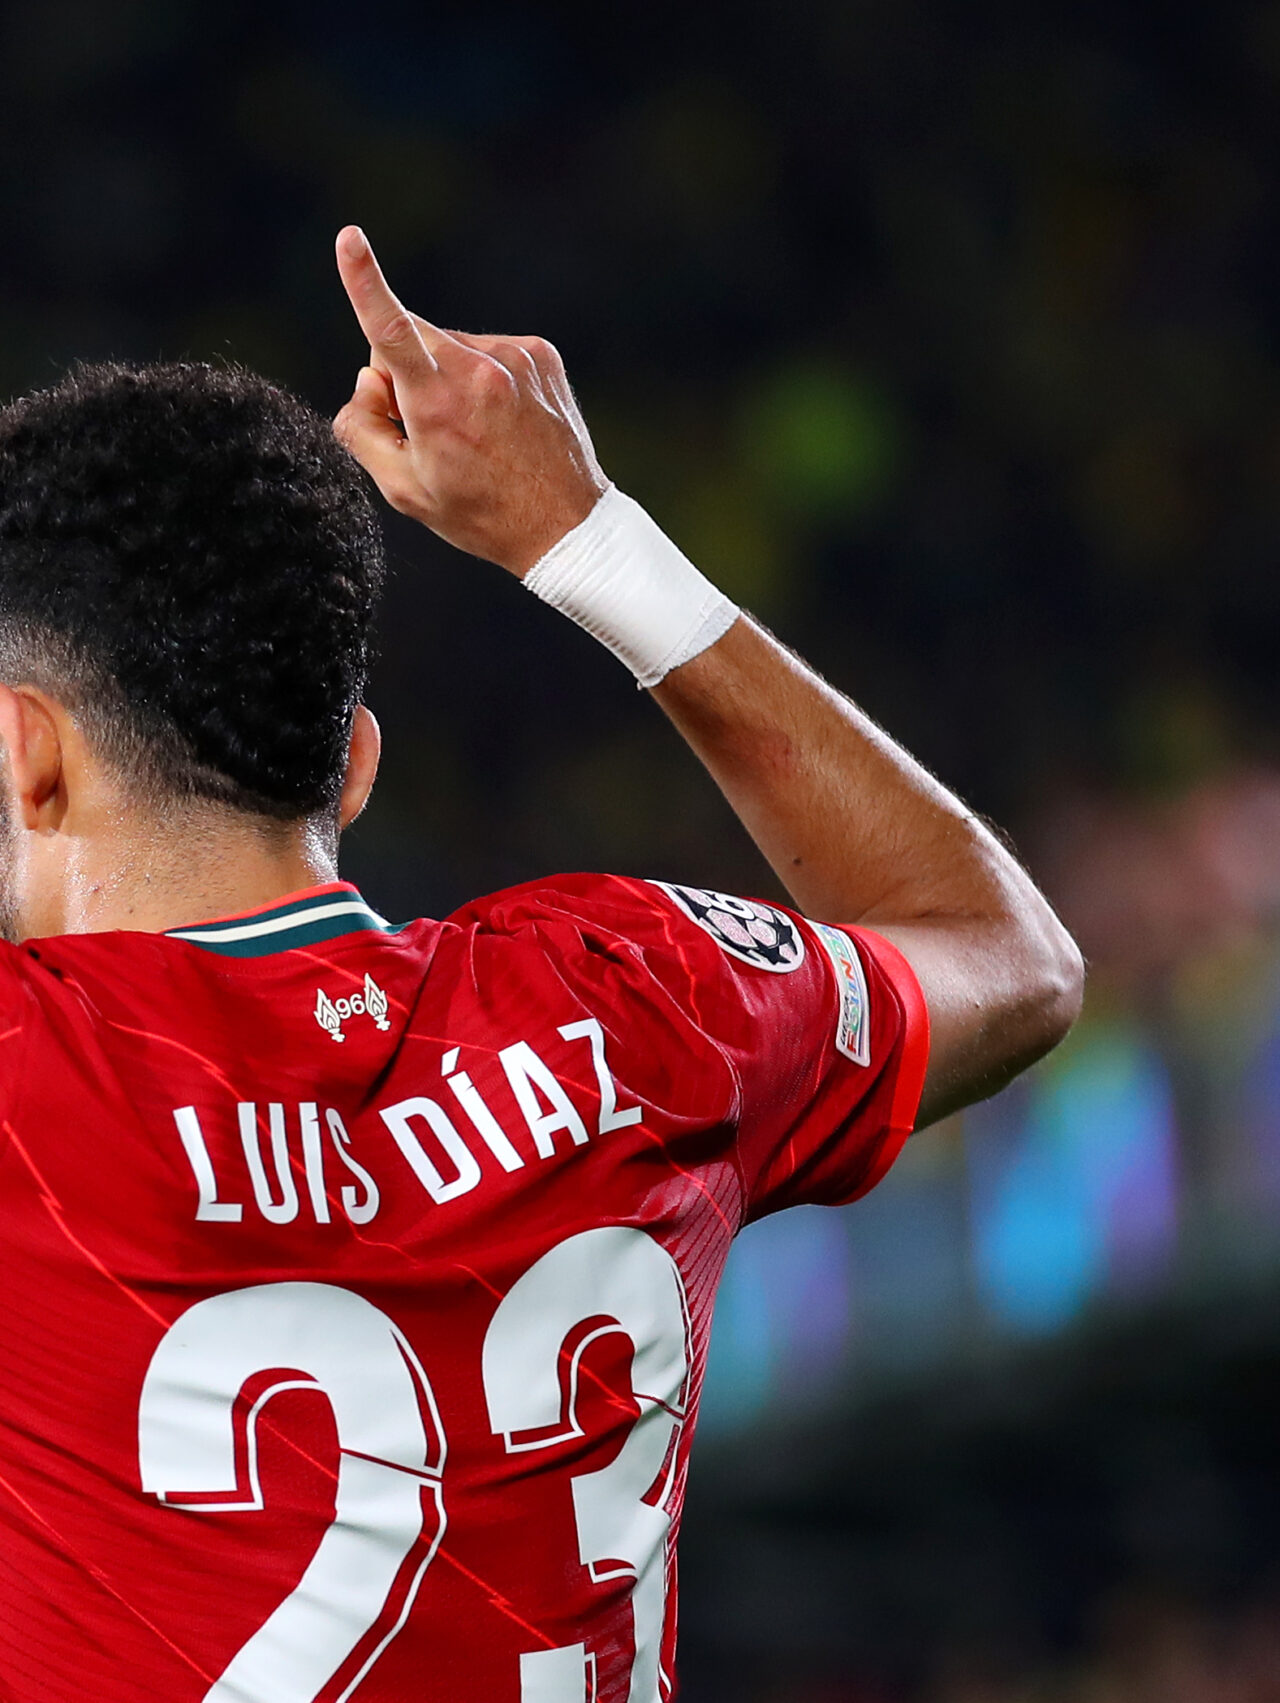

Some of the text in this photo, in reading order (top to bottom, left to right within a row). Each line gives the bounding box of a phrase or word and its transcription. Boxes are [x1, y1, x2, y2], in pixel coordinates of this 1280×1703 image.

[334, 992, 366, 1020] 96
[172, 1017, 643, 1225] LUIS DÍAZ
[138, 1225, 694, 1703] 23
